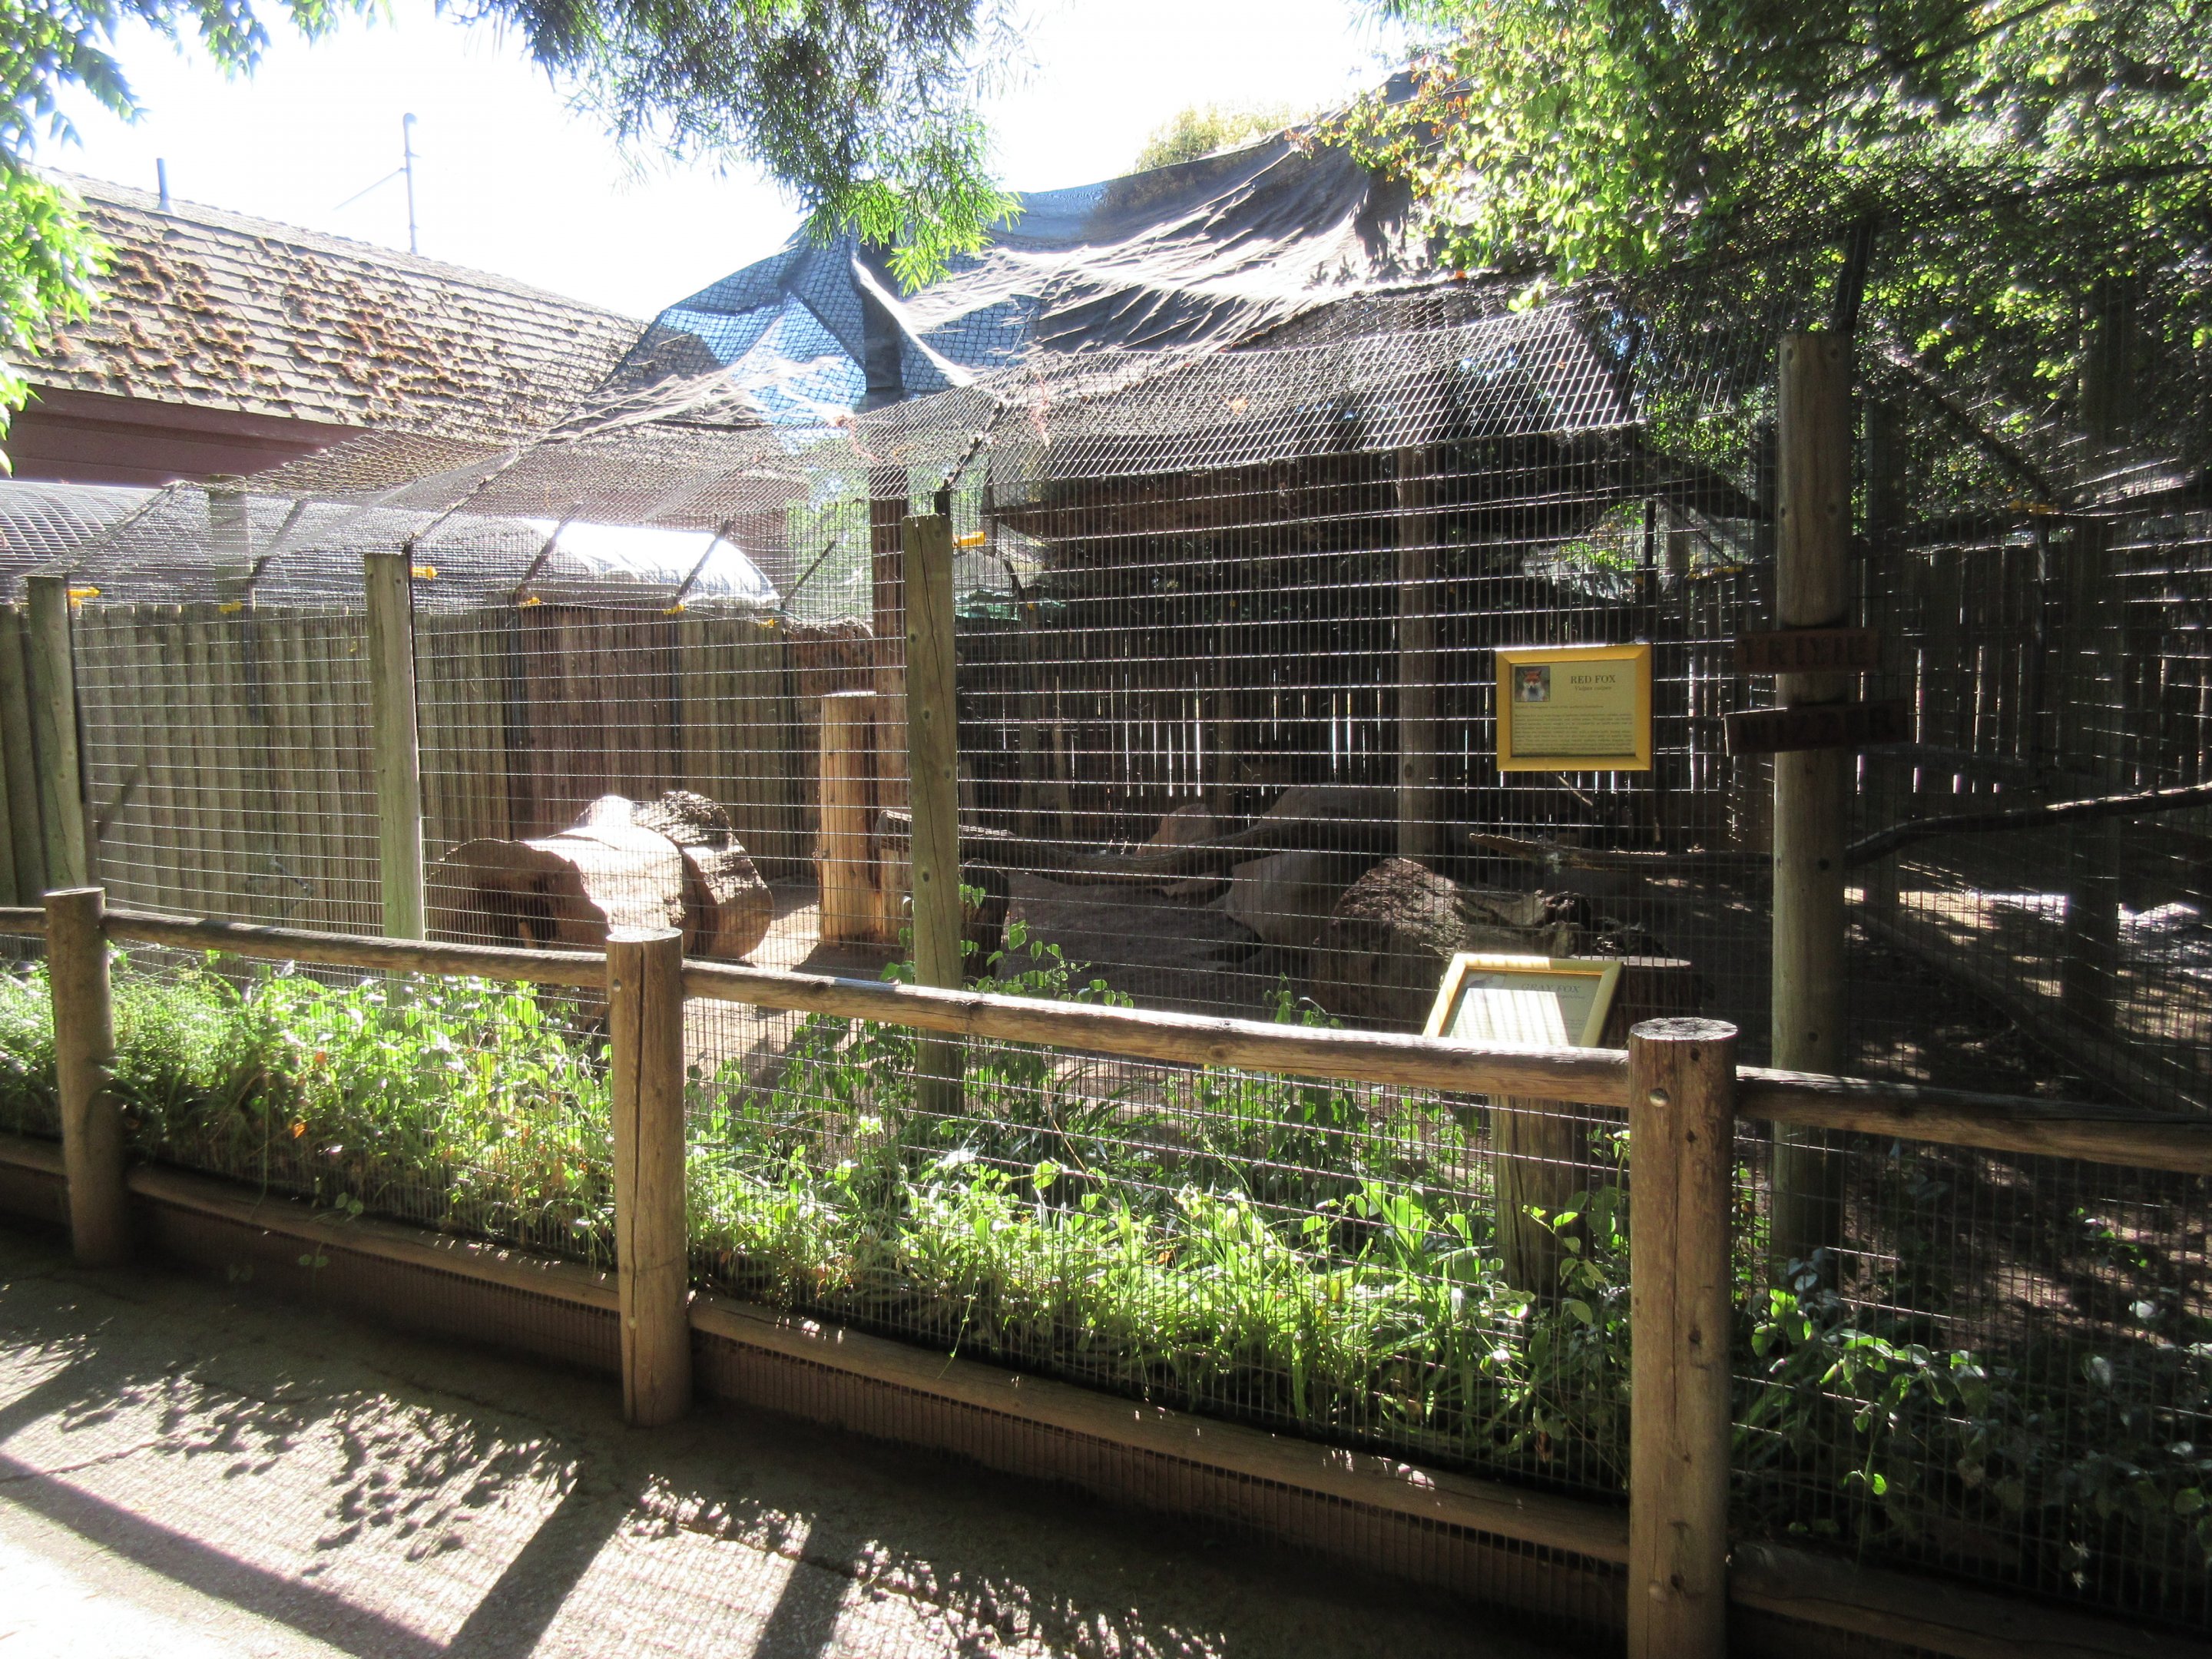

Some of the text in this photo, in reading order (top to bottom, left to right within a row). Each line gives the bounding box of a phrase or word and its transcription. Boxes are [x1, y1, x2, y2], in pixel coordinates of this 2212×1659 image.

[1741, 634, 1869, 666] TRIXIE
[1570, 674, 1616, 684] RED FOX
[1521, 983, 1581, 993] GRAY FOX
